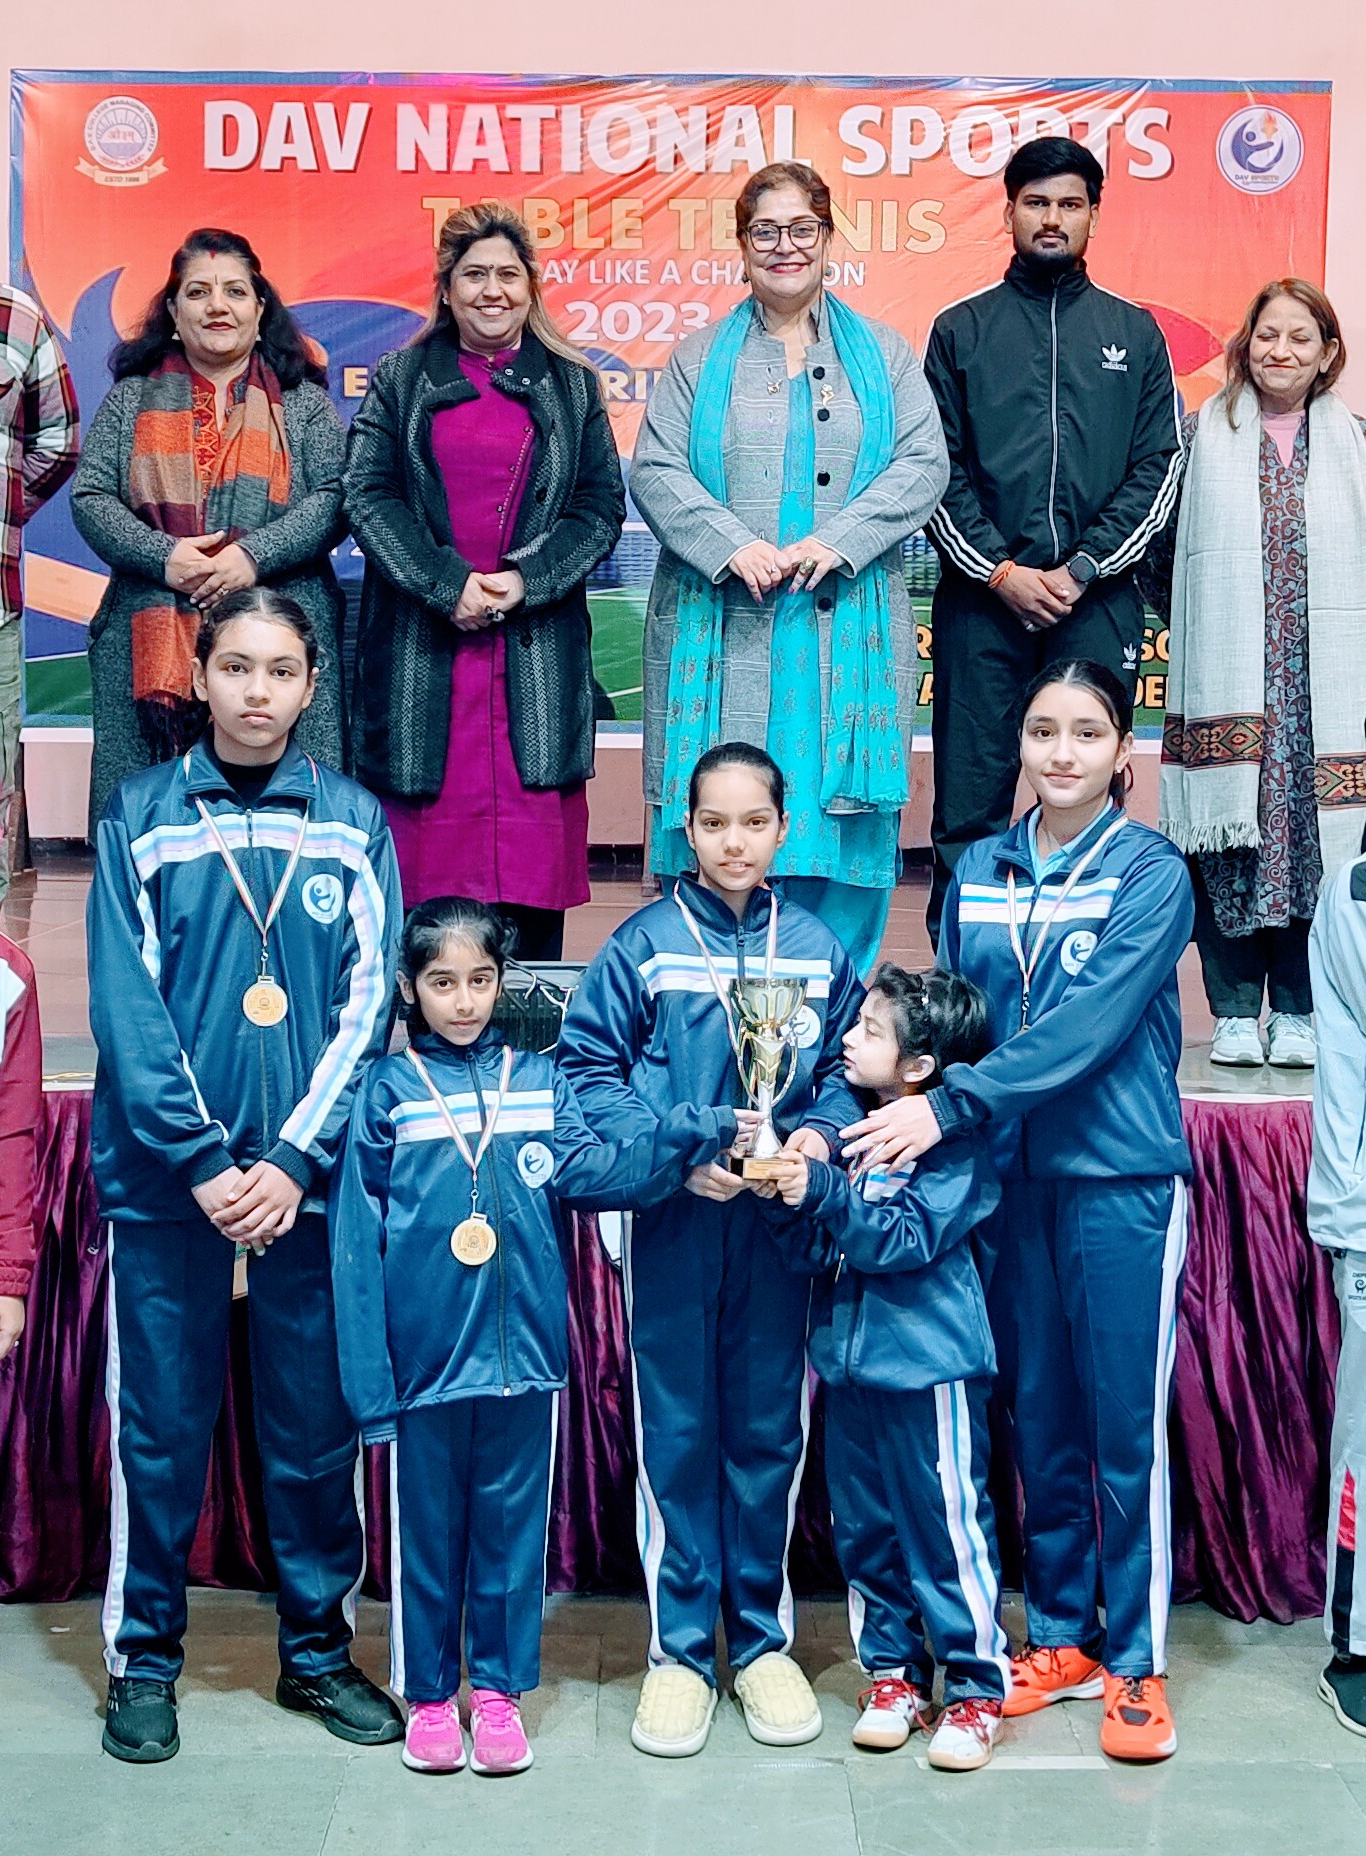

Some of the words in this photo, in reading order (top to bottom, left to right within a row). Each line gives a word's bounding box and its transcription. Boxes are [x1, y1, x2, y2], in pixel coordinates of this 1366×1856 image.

[203, 100, 373, 171] DAV
[395, 103, 813, 175] NATIONAL
[422, 196, 645, 251] TBLE
[668, 198, 948, 255] TENIS
[589, 259, 651, 285] LIKE
[659, 260, 682, 286] A
[690, 259, 866, 287] CHON
